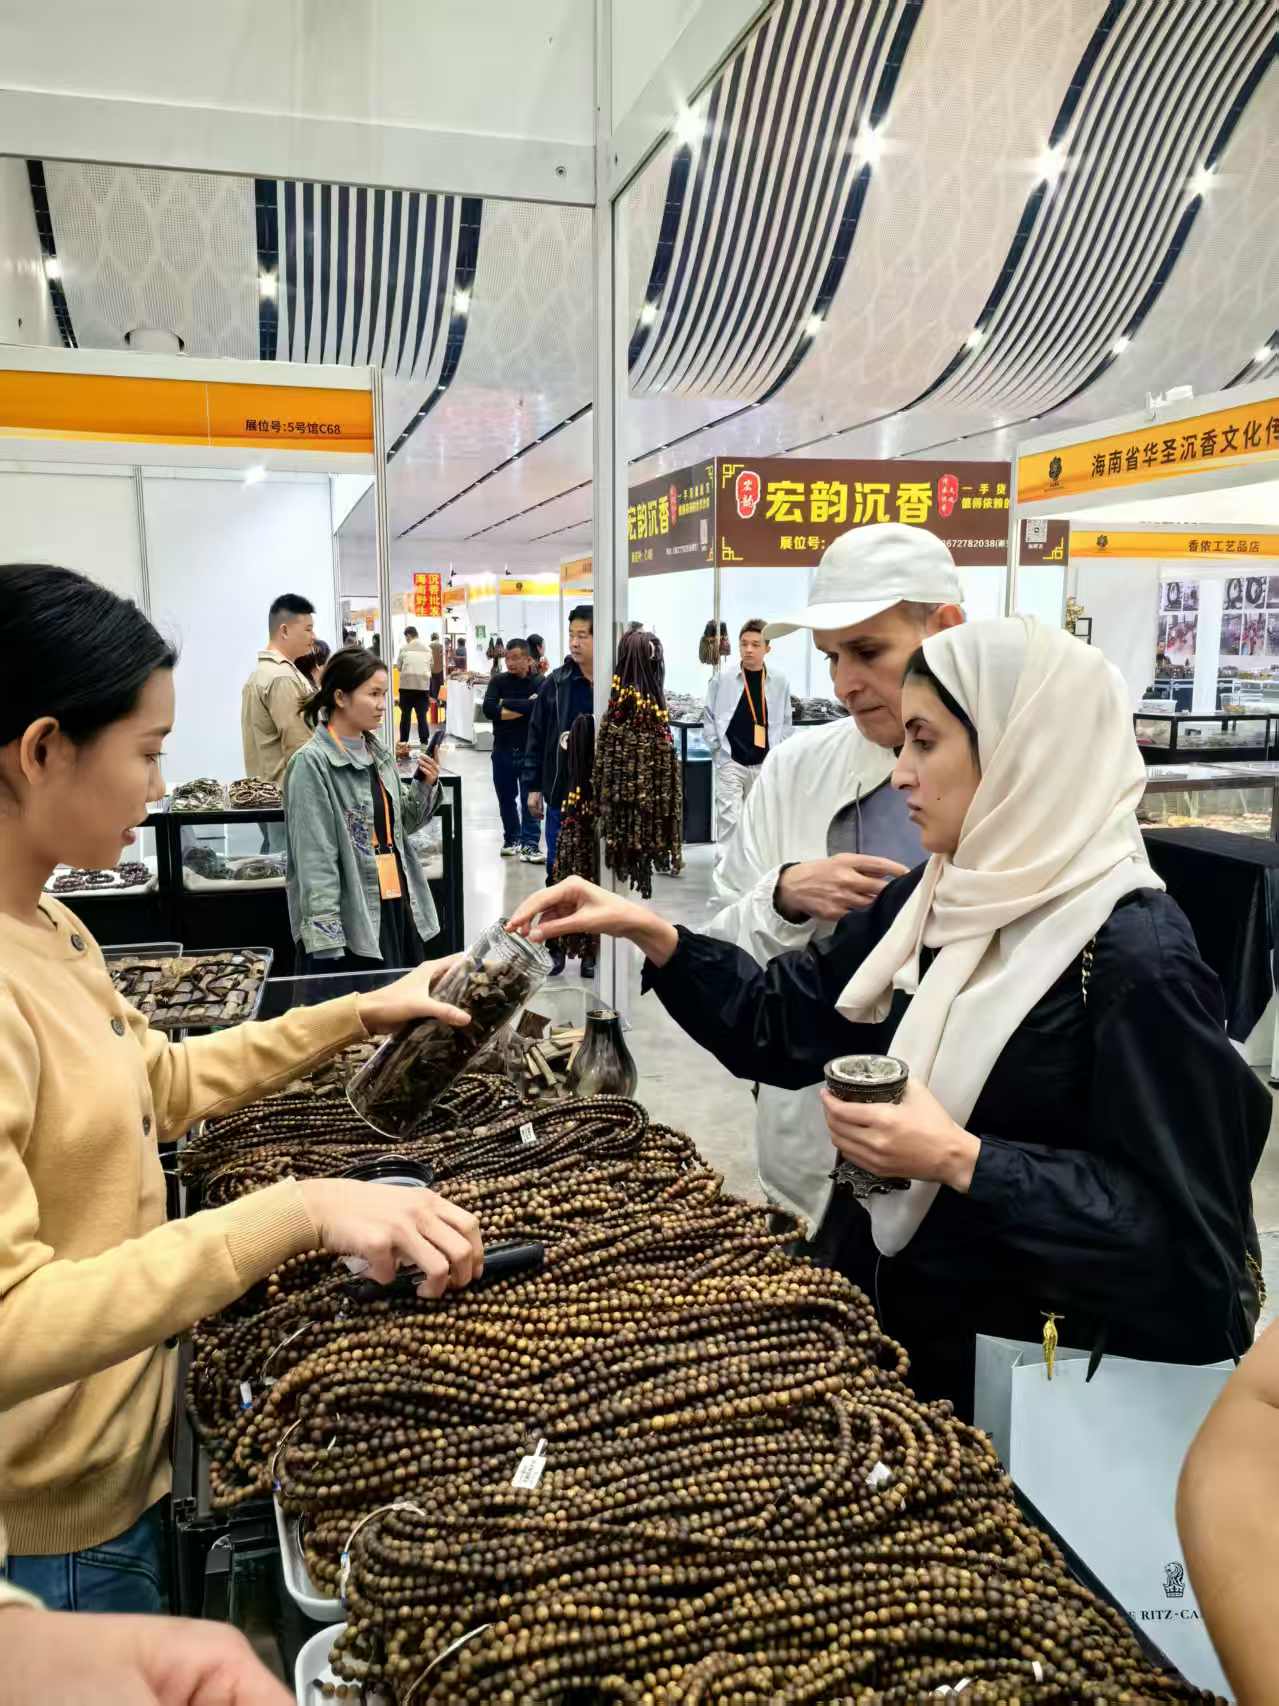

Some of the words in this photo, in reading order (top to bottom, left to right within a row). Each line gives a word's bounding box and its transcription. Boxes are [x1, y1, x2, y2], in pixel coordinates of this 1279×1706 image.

[245, 419, 341, 434] 展位号:5号馆C68
[1091, 416, 1279, 477] 海南省华圣沉香文化传
[628, 496, 669, 540] 宏韵沉香
[766, 480, 933, 524] 宏韵沉香
